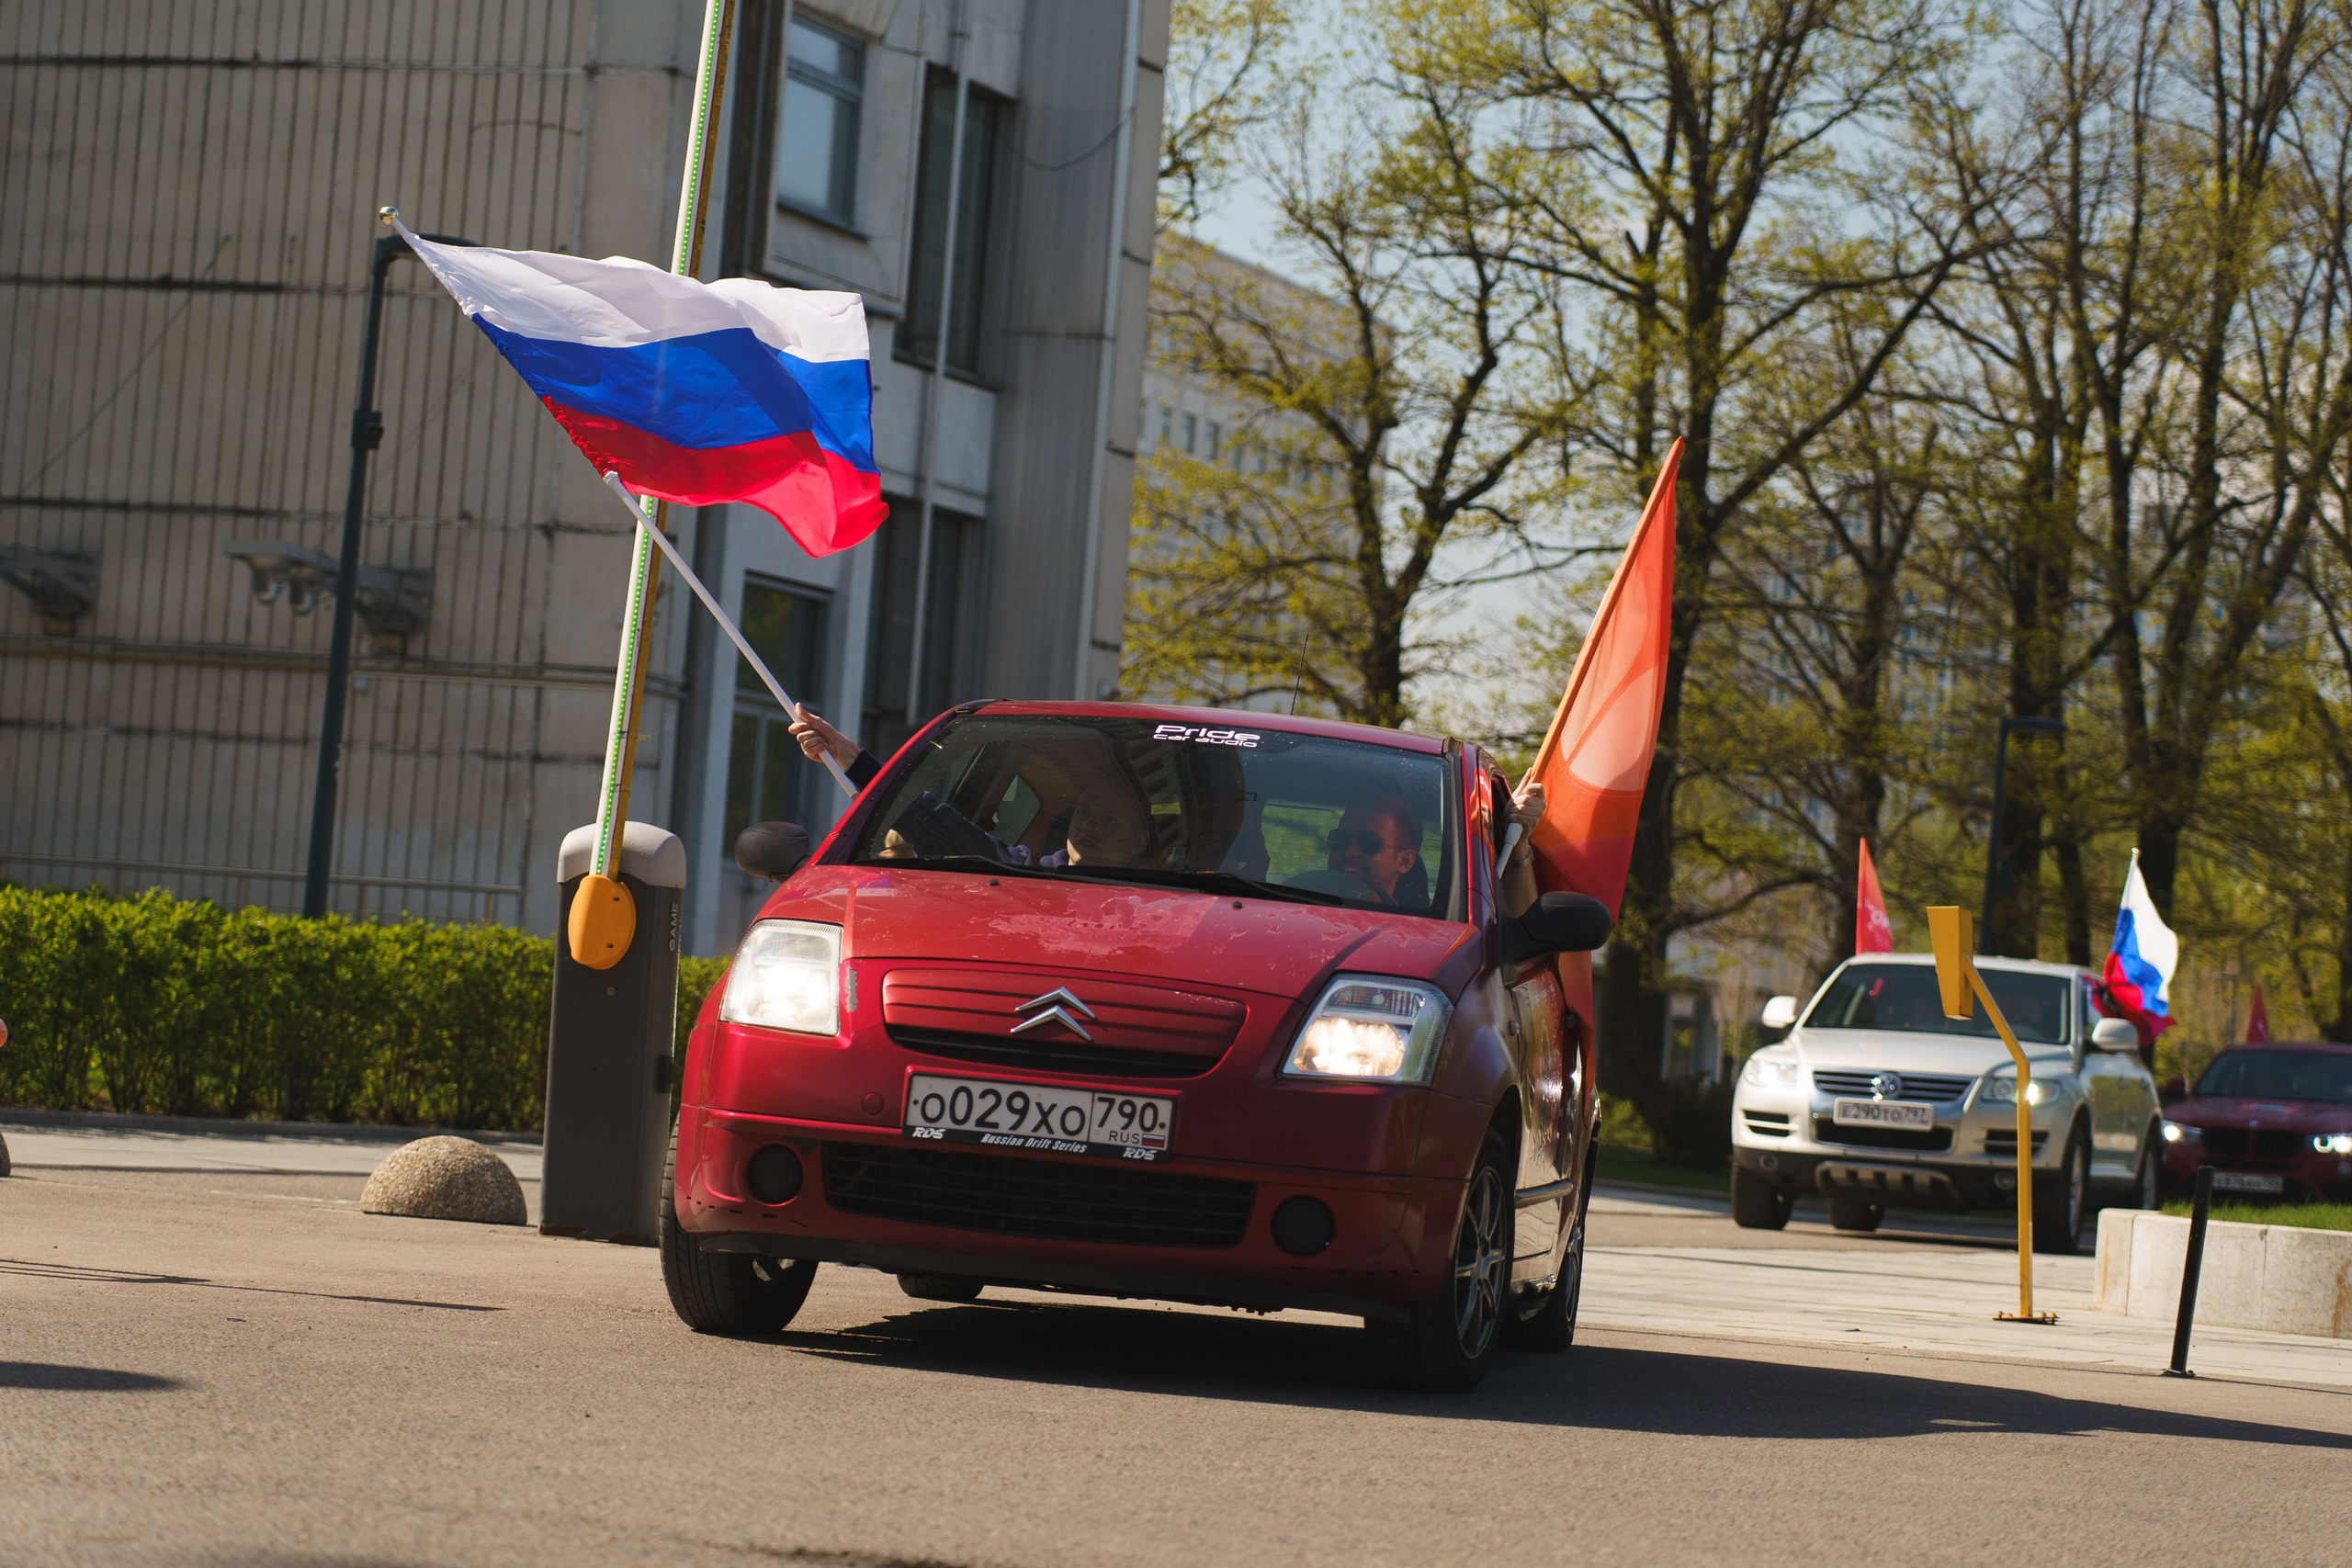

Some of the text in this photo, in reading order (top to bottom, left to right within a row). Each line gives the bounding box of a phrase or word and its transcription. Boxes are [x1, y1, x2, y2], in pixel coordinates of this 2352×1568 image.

[1155, 725, 1261, 740] Pride
[1194, 738, 1258, 747] audio
[1097, 1096, 1159, 1133] 790
[912, 1126, 946, 1139] RDS
[1108, 1130, 1140, 1145] RUS
[980, 1133, 1087, 1154] Russian Drift Series
[1123, 1146, 1156, 1160] RDS
